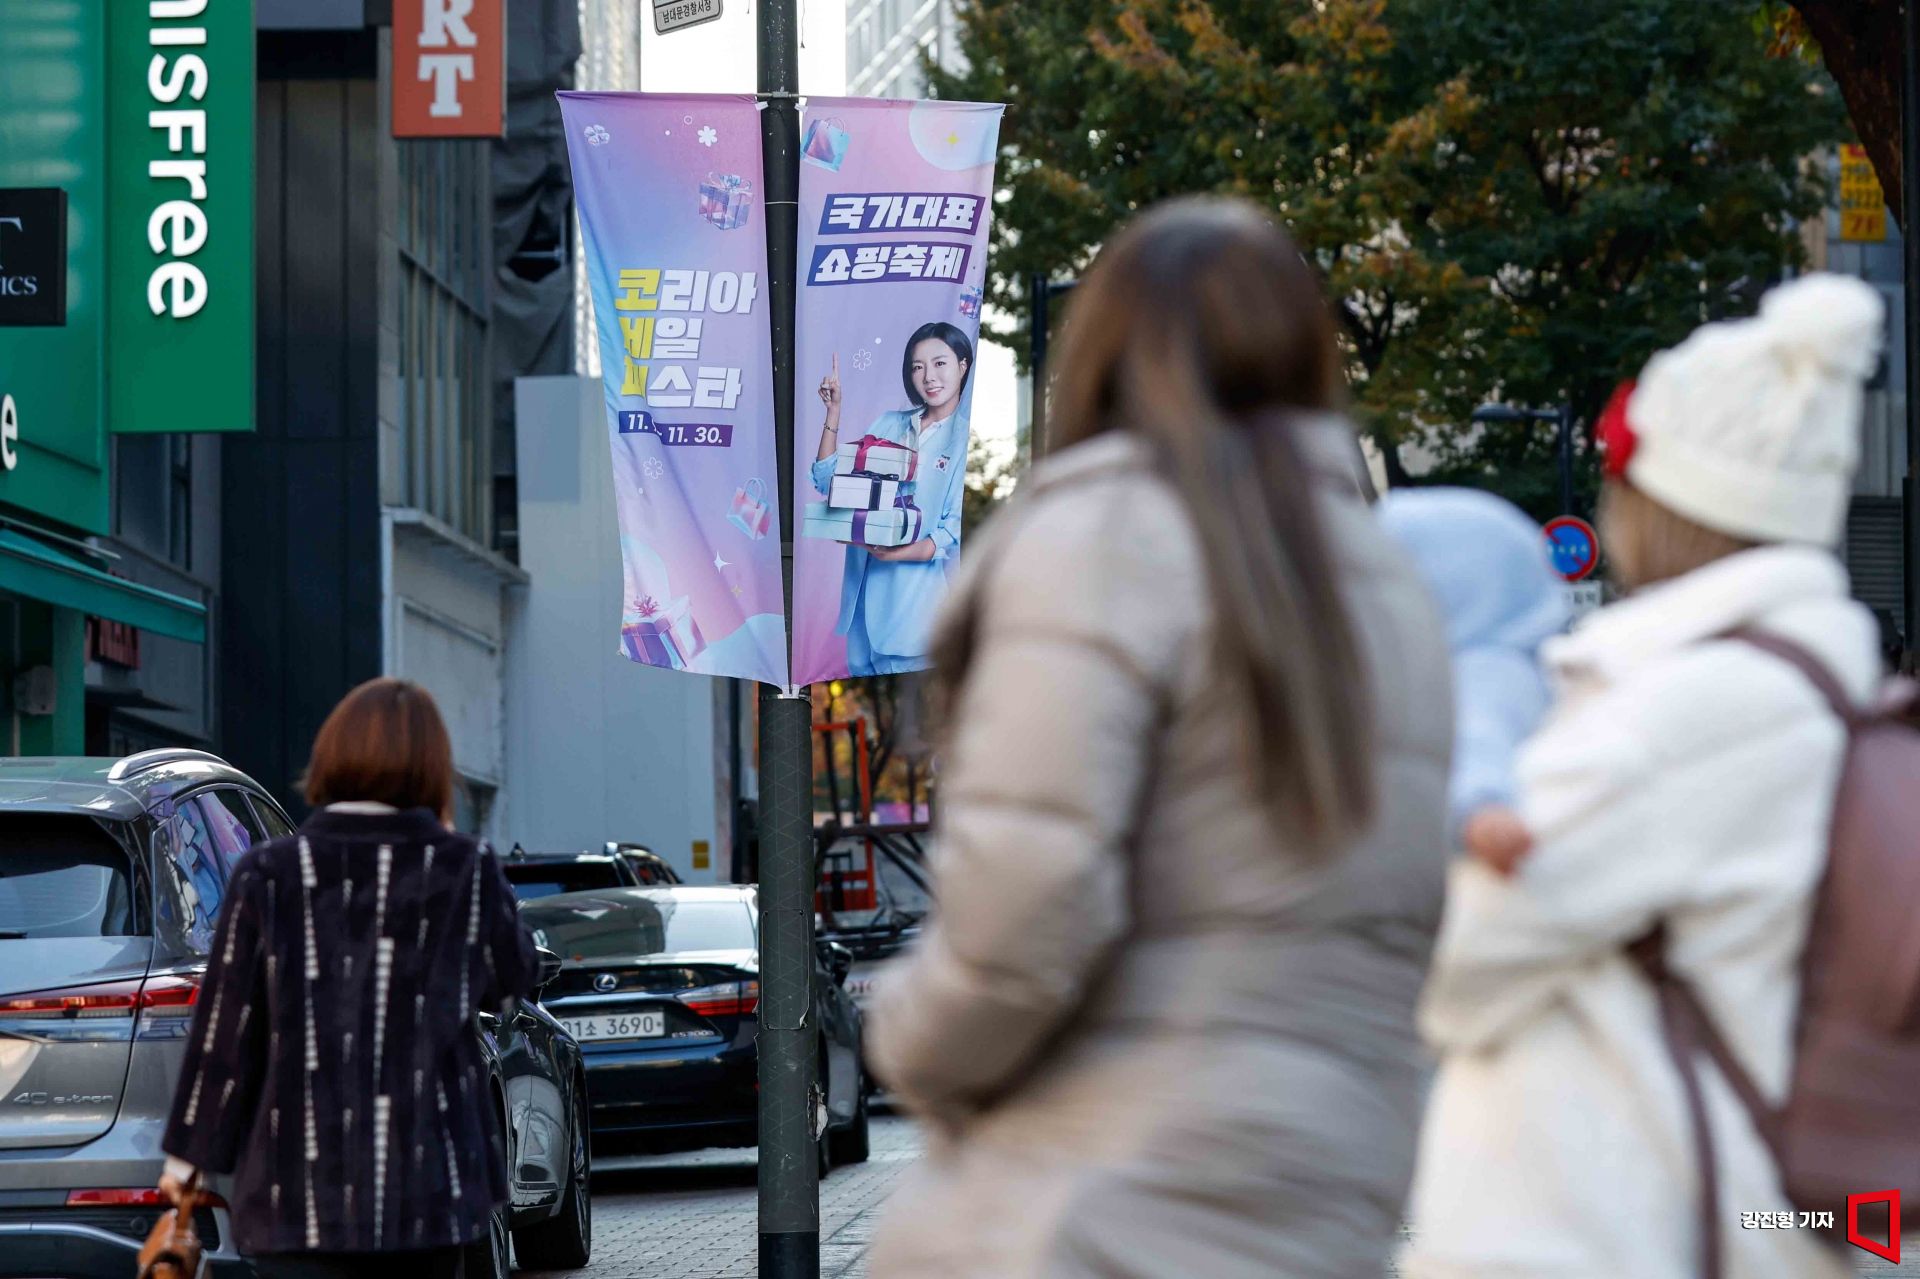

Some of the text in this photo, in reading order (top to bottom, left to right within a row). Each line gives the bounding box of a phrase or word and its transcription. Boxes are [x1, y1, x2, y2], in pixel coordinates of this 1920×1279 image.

[828, 196, 978, 229] 국가대표
[814, 244, 966, 282] 쇼핑축제
[615, 268, 757, 314] 코리아
[628, 413, 648, 430] 11.
[668, 426, 688, 443] 11.
[694, 426, 723, 444] 30.
[606, 1016, 654, 1035] 3690
